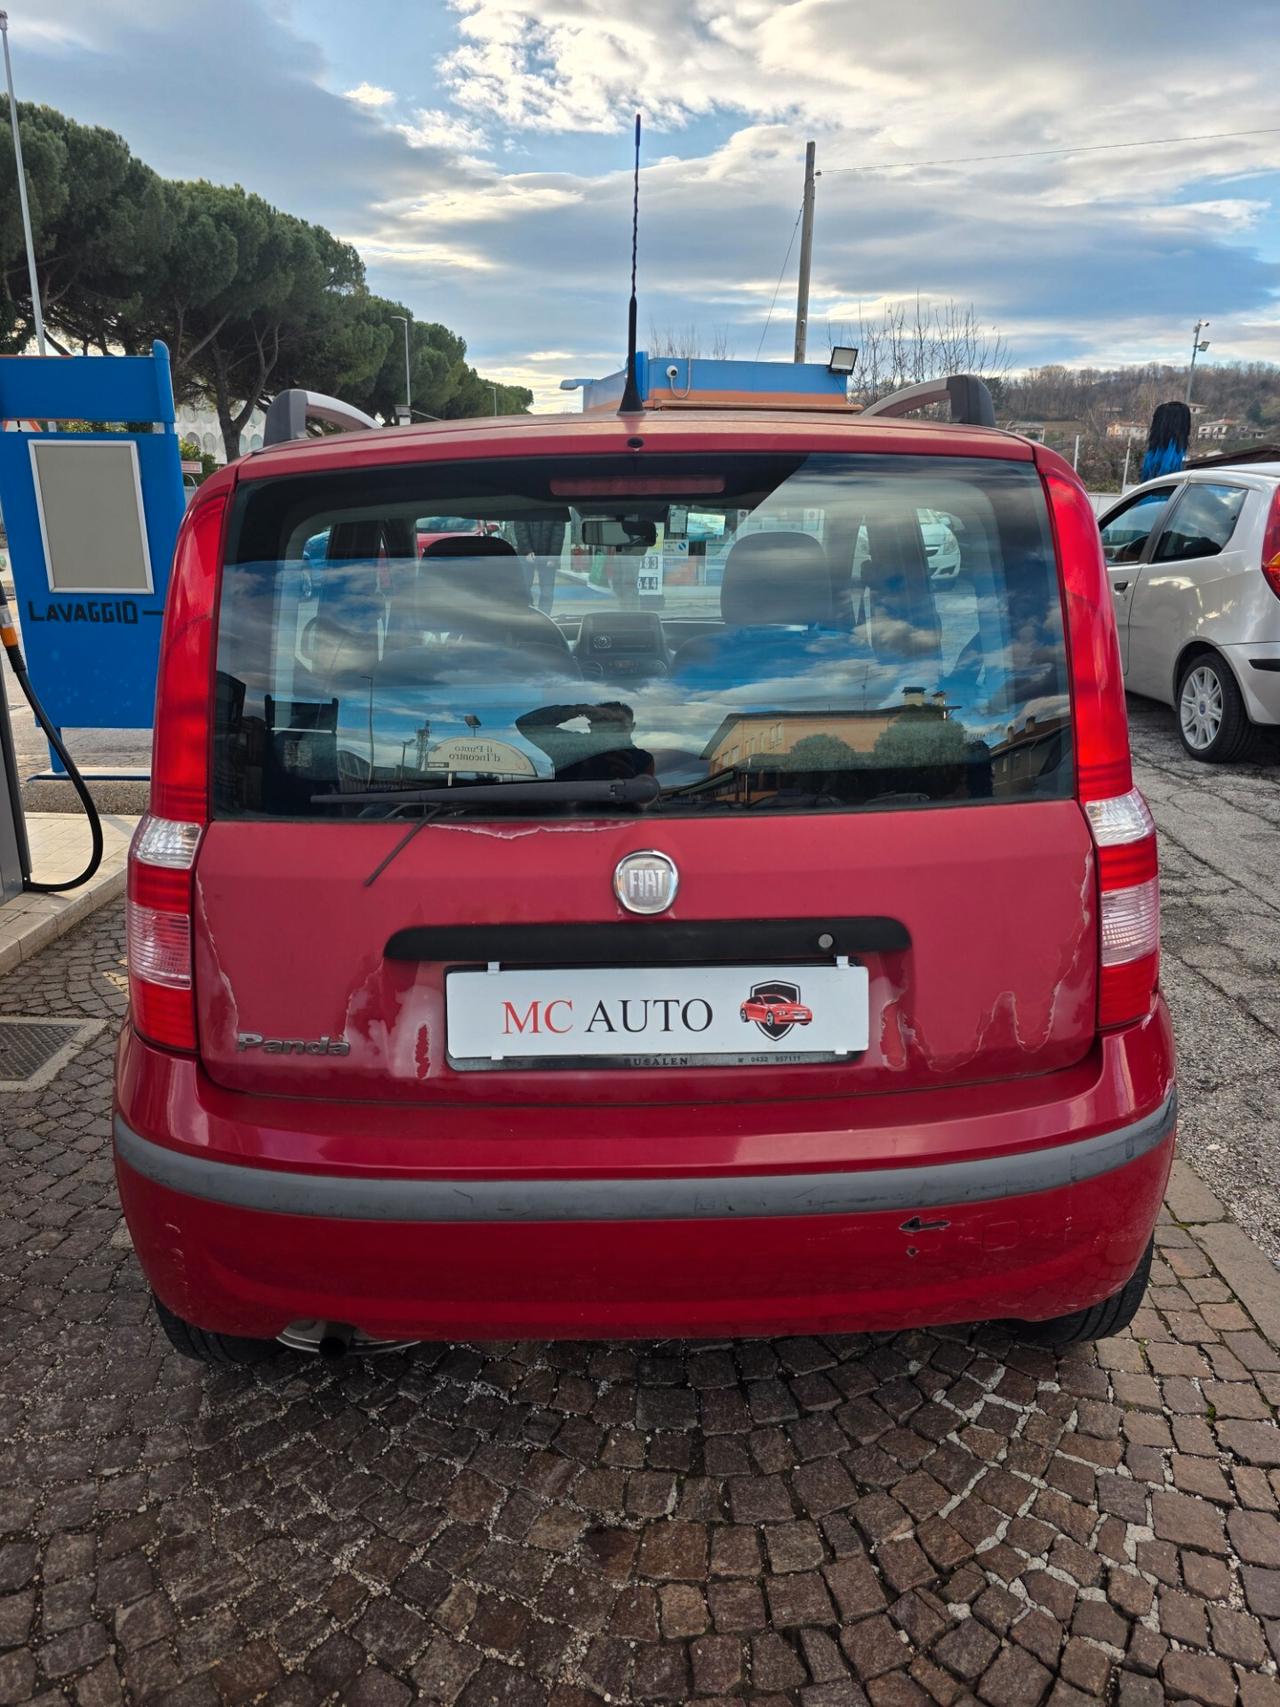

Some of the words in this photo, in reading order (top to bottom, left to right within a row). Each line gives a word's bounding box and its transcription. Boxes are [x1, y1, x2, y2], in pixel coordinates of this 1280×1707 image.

[28, 600, 138, 624] LAVAGGIO
[629, 869, 666, 897] FIAT
[501, 999, 574, 1034] MC
[584, 998, 713, 1033] AUTO
[236, 1032, 351, 1056] Panda
